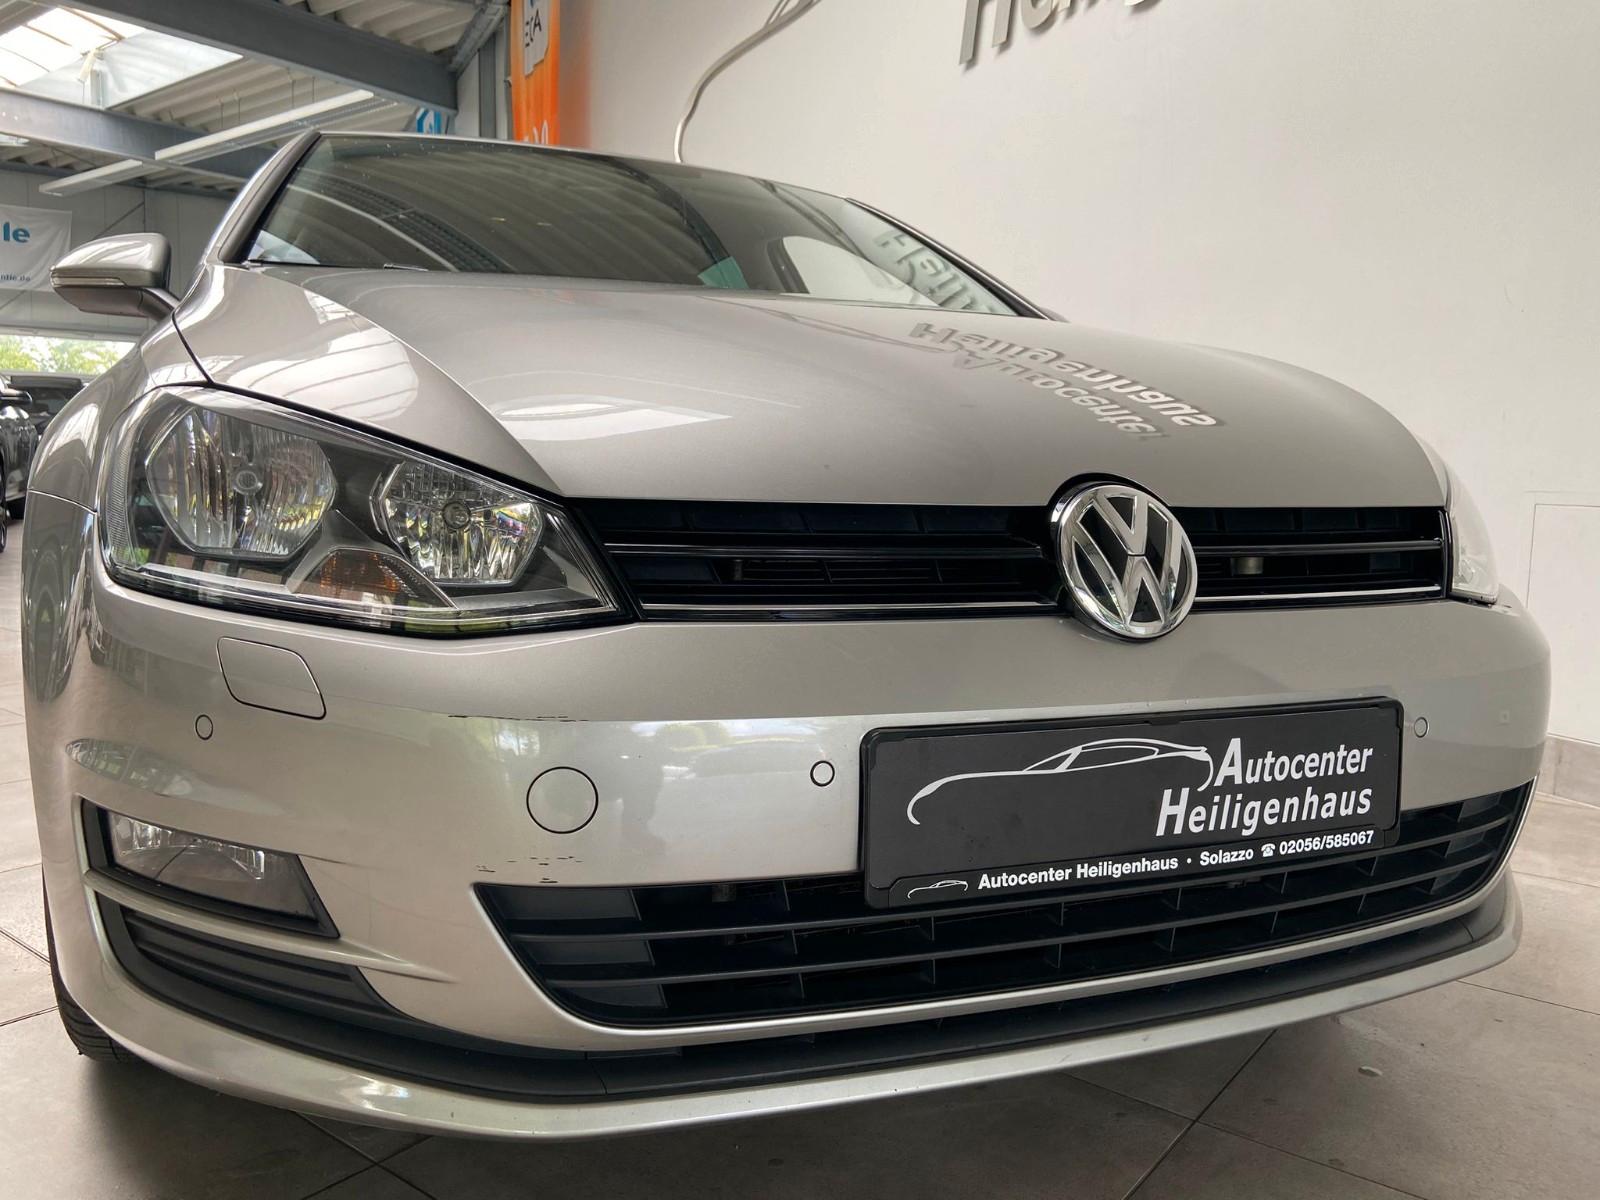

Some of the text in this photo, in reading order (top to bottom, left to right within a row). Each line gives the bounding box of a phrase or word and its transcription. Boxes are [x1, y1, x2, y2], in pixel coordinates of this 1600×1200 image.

[1213, 738, 1373, 787] Autocenter
[1156, 786, 1372, 837] Heiligenhaus
[977, 830, 1374, 889] Autocenter Heiligenhaus Solazzo 02056/585067
